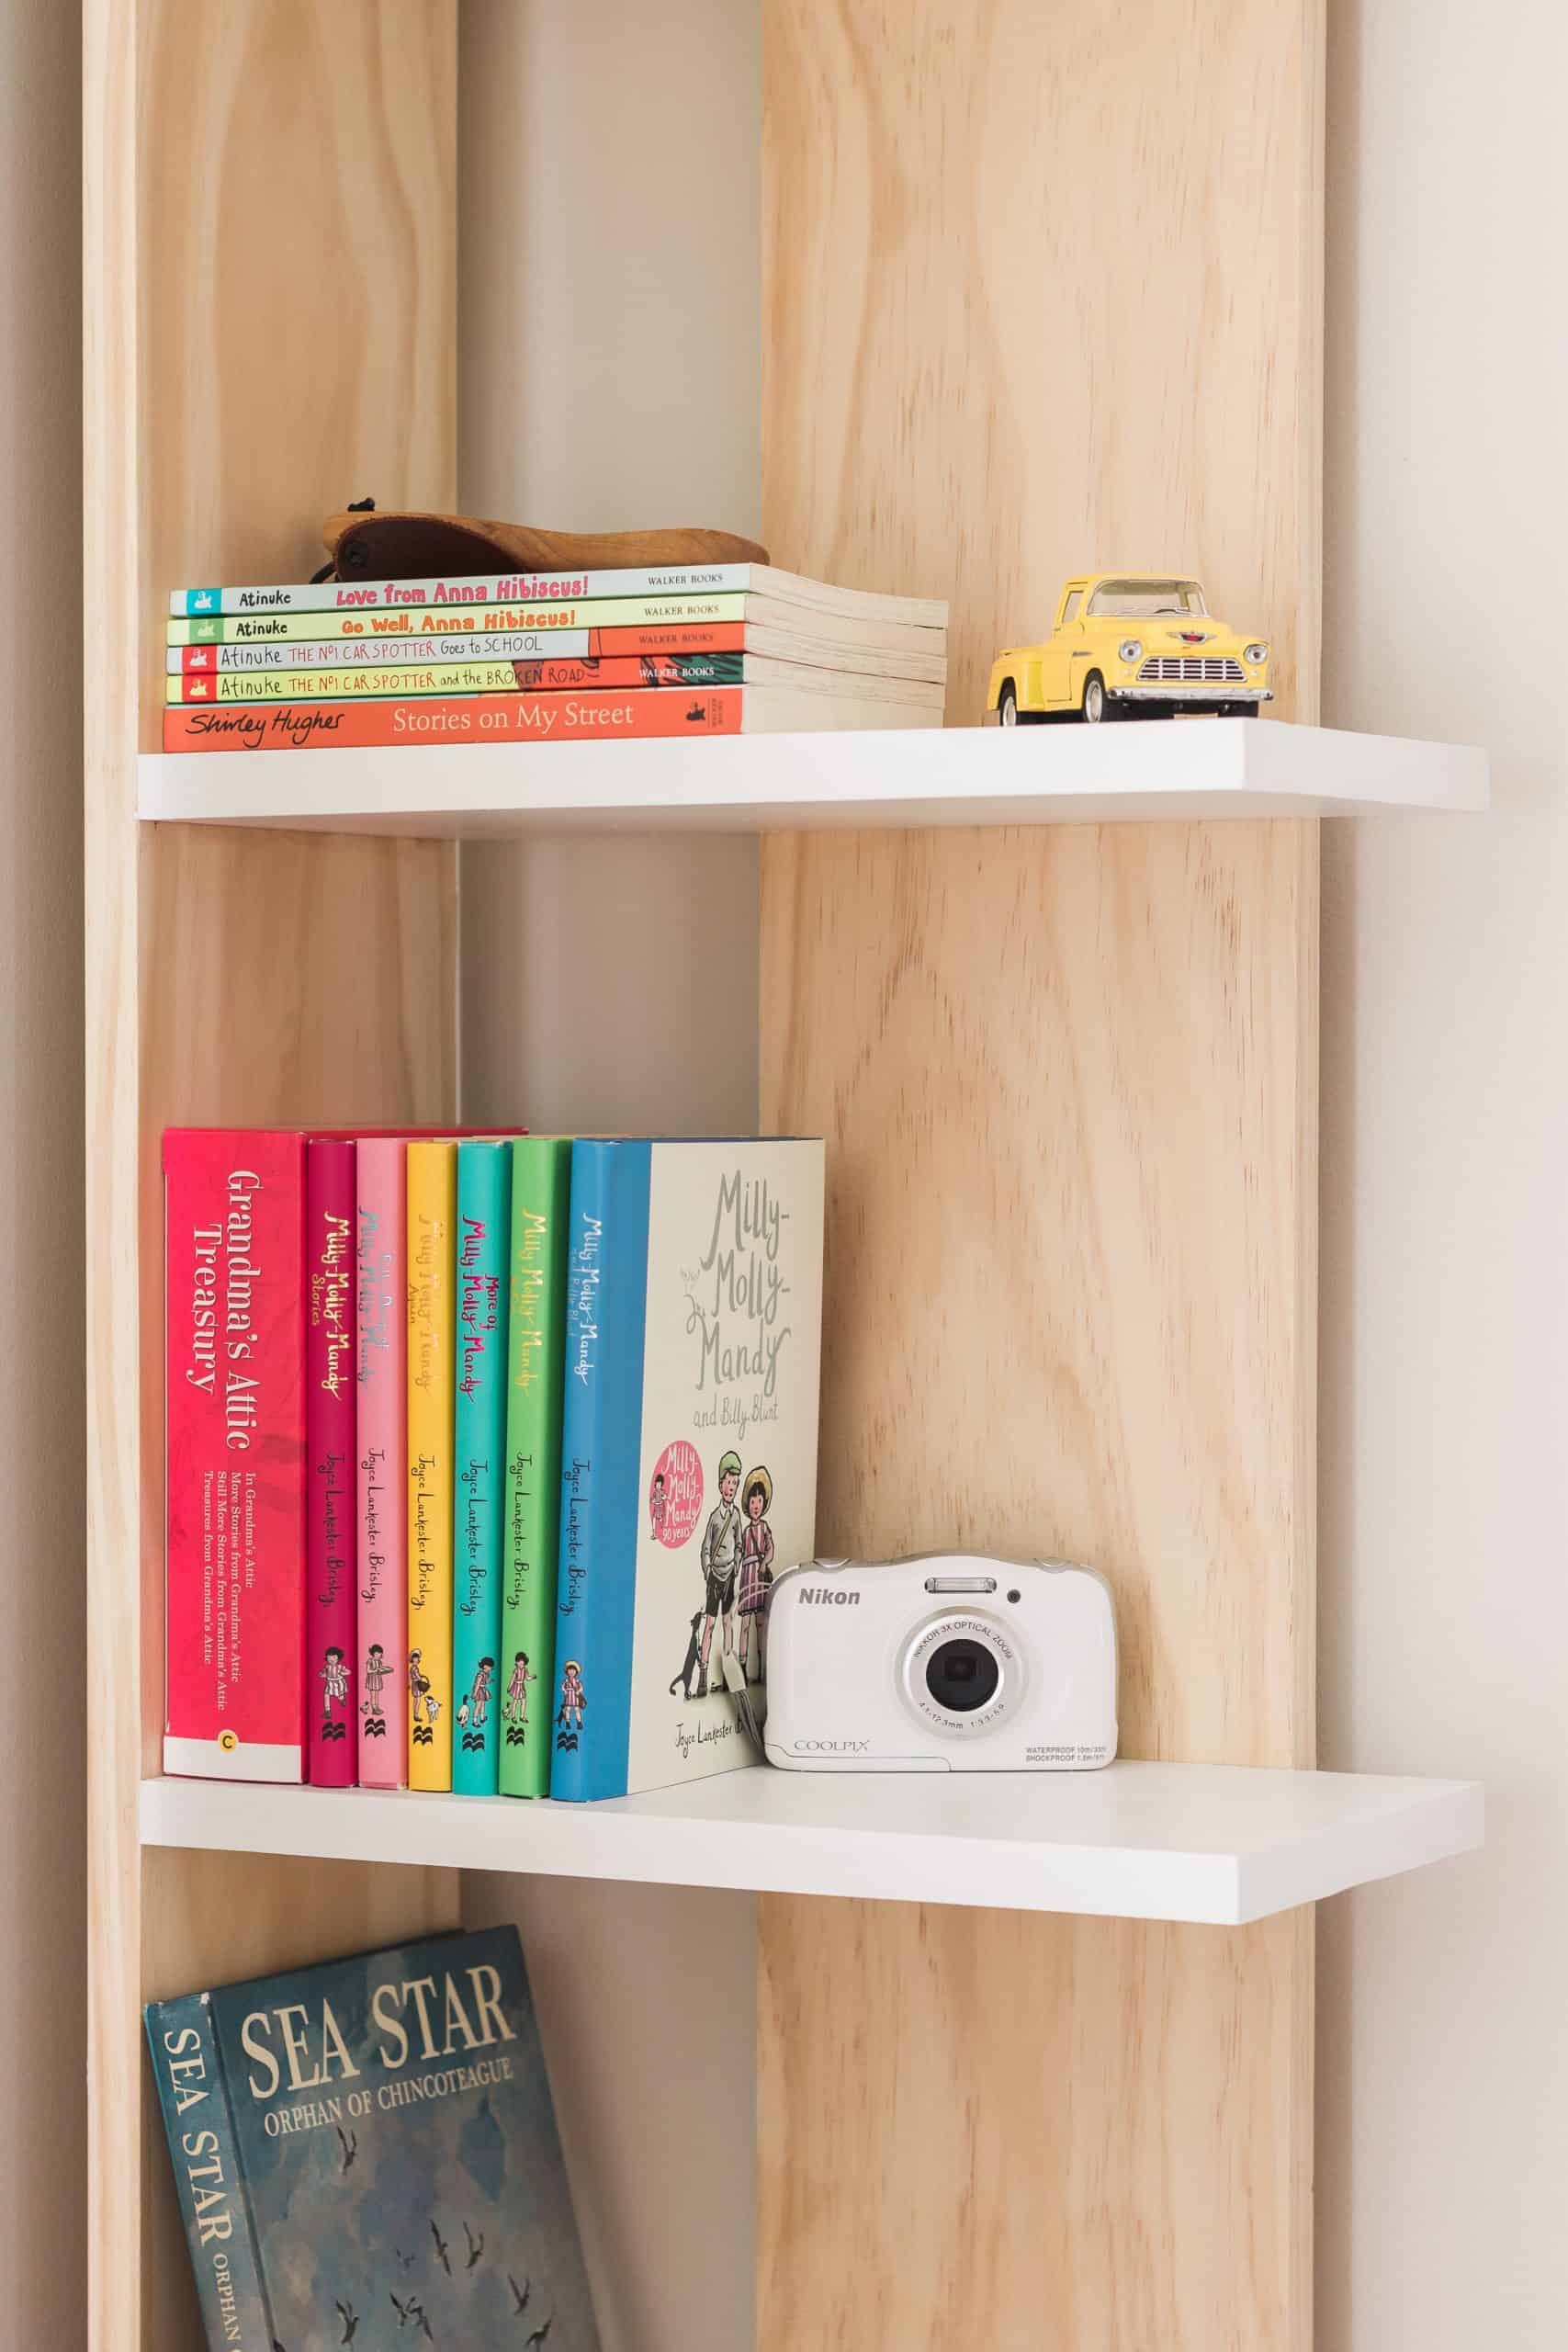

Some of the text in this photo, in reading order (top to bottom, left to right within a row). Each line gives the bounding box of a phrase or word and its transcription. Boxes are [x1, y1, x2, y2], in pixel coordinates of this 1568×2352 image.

[239, 589, 292, 607] Atinuke
[336, 575, 589, 606] Love from Anna Hibiscus!
[648, 572, 724, 586] WALKER BOOKS
[236, 619, 288, 637] Atinuke
[342, 609, 576, 634] Go Well, Anna Hibiscus!
[645, 604, 719, 617] WALKER BOOKS
[221, 646, 283, 667] Atinuke
[288, 647, 314, 662] THE
[343, 645, 369, 661] CAR
[372, 639, 436, 660] SPOTTER
[440, 640, 465, 656] Goes
[468, 640, 481, 654] to
[484, 636, 543, 652] SCHOOL
[639, 632, 714, 644] WALKER BOOKS
[221, 676, 283, 697] Atinuke
[288, 677, 314, 693] THE
[343, 674, 369, 690] CAR
[372, 672, 436, 689] SPOTTER
[440, 670, 459, 686] and
[463, 668, 482, 684] the
[487, 667, 542, 684] BROKEN
[548, 668, 585, 684] ROAD
[639, 667, 715, 678] WALKER BOOKS
[185, 712, 266, 749] Shirley
[393, 701, 635, 735] Stories on My Street
[699, 1169, 791, 1272] Milly-
[186, 1222, 222, 1395] Treasury
[225, 1170, 265, 1451] Grandma's Attic
[310, 1273, 326, 1328] Stories
[479, 1273, 500, 1331] More of
[710, 1250, 792, 1326] Molly-
[695, 1316, 792, 1398] Mandy
[693, 1393, 780, 1441] and Billy Blunt
[245, 1472, 257, 1589] In Grandma's Attic
[318, 1452, 346, 1609] Joyce Lankester Brisley
[361, 1447, 385, 1603] Joyce Lankester Brisley
[412, 1453, 435, 1610] Joyce Lankester Brisley
[506, 1452, 533, 1610] Joyce Lankester Brisley
[666, 1493, 703, 1530] Mandy
[460, 1459, 489, 1617] Joyce Lankester Brisley
[558, 1459, 591, 1617] Joyce Lankester Brisley
[203, 1470, 214, 1665] Treasures from Grandma's Attic
[217, 1470, 229, 1711] Still More Stories from Grandma's Attic
[231, 1471, 243, 1683] More Stories from Grandma's Attic
[798, 1587, 861, 1606] Nikon
[942, 1623, 953, 1633] 3X
[954, 1621, 993, 1637] OPTICAL
[992, 1634, 1013, 1660] ZOOM
[222, 1736, 233, 1749] C
[675, 1722, 696, 1758] Joyce
[697, 1719, 733, 1745] Lankester
[794, 1739, 870, 1756] COOLPIX
[241, 1964, 517, 2100] SEA STAR
[263, 2056, 514, 2137] ORPHAN OF CHINCOTEAGUE
[164, 2027, 243, 2342] SEA STAR ORPHAN
